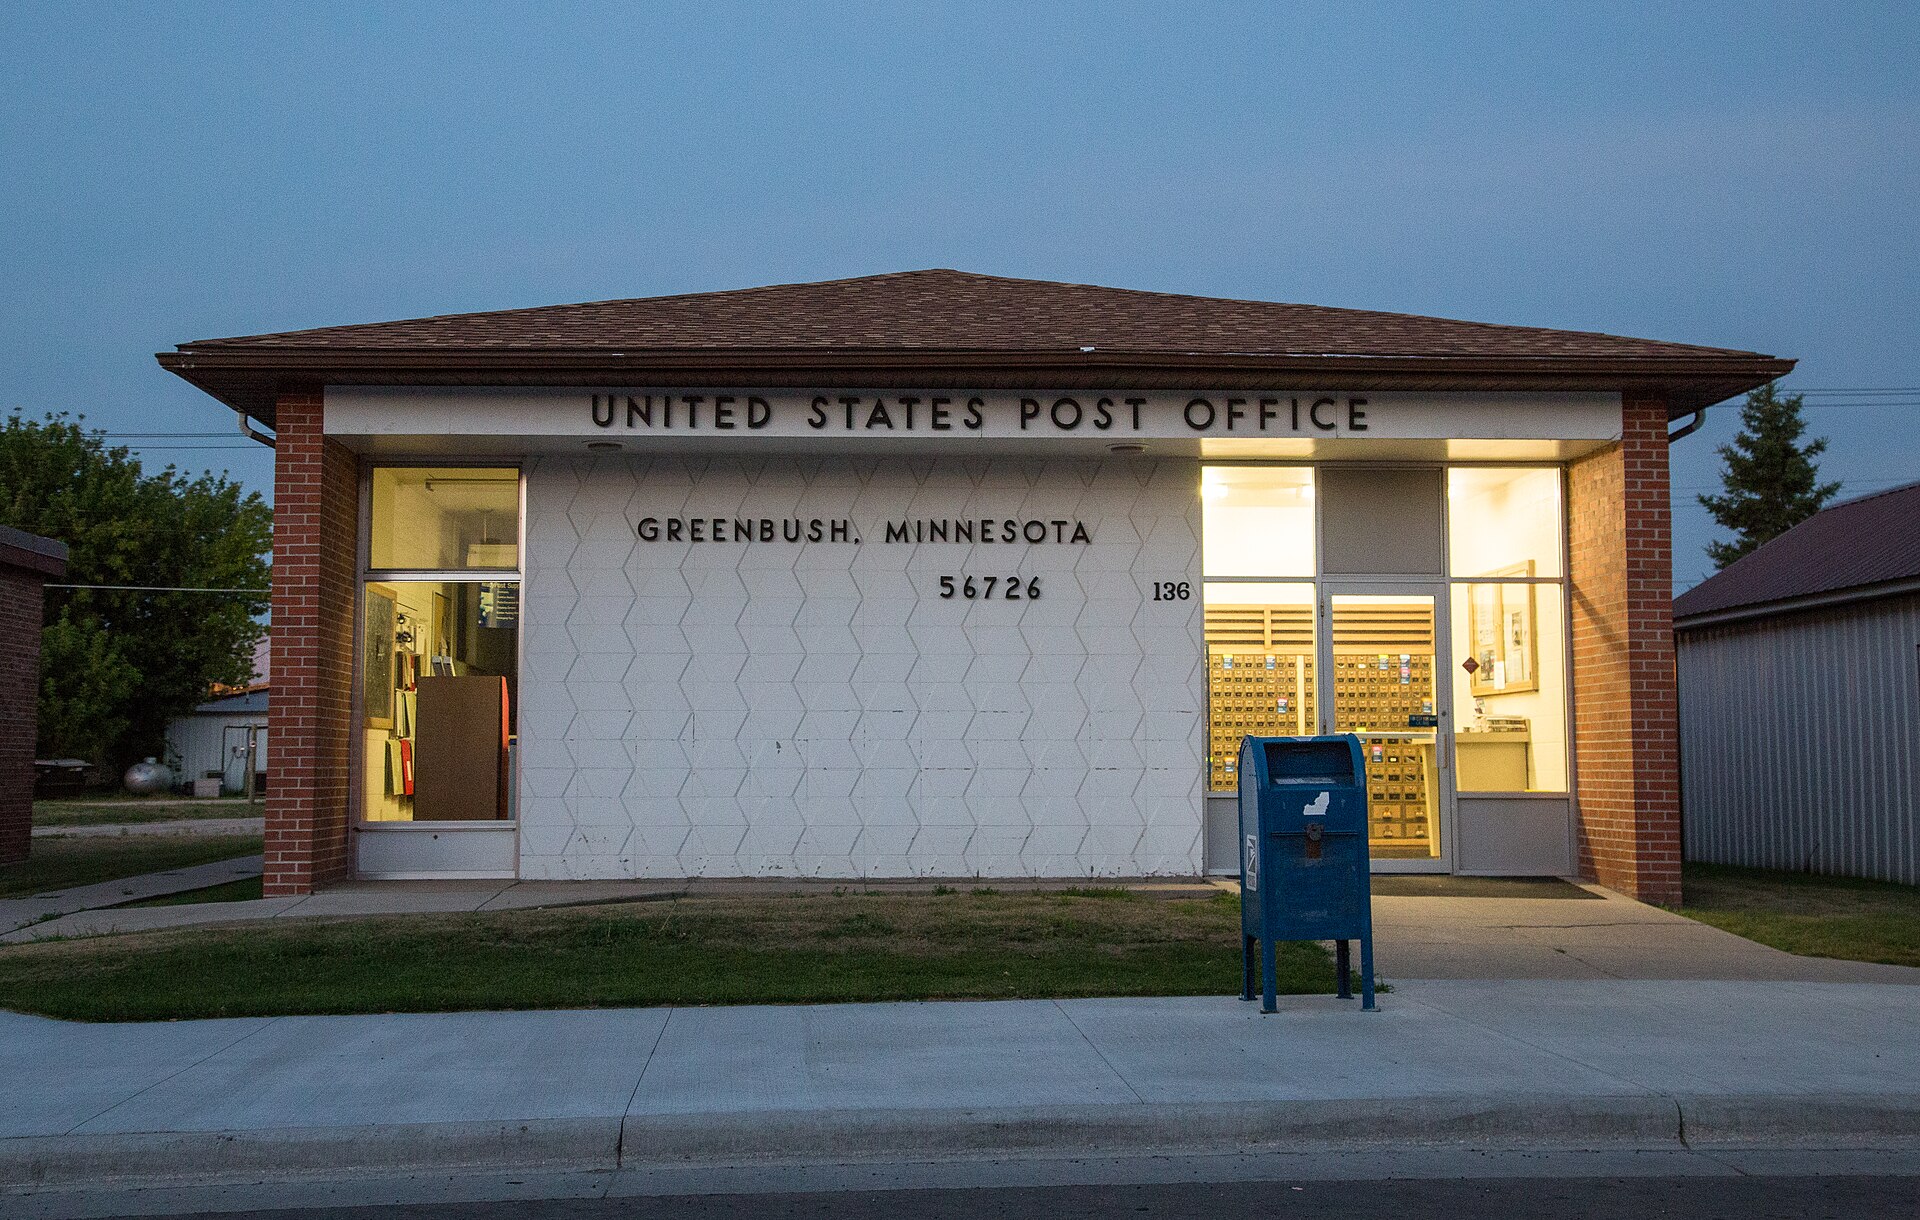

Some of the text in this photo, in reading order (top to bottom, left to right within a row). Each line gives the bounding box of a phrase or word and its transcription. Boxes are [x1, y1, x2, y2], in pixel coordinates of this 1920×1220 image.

[591, 395, 1368, 431] UNITED STATES POST OFFICE
[638, 518, 1091, 544] GREENBUSH, MINNESOTA
[940, 575, 1041, 600] 56726
[1153, 582, 1190, 601] 136
